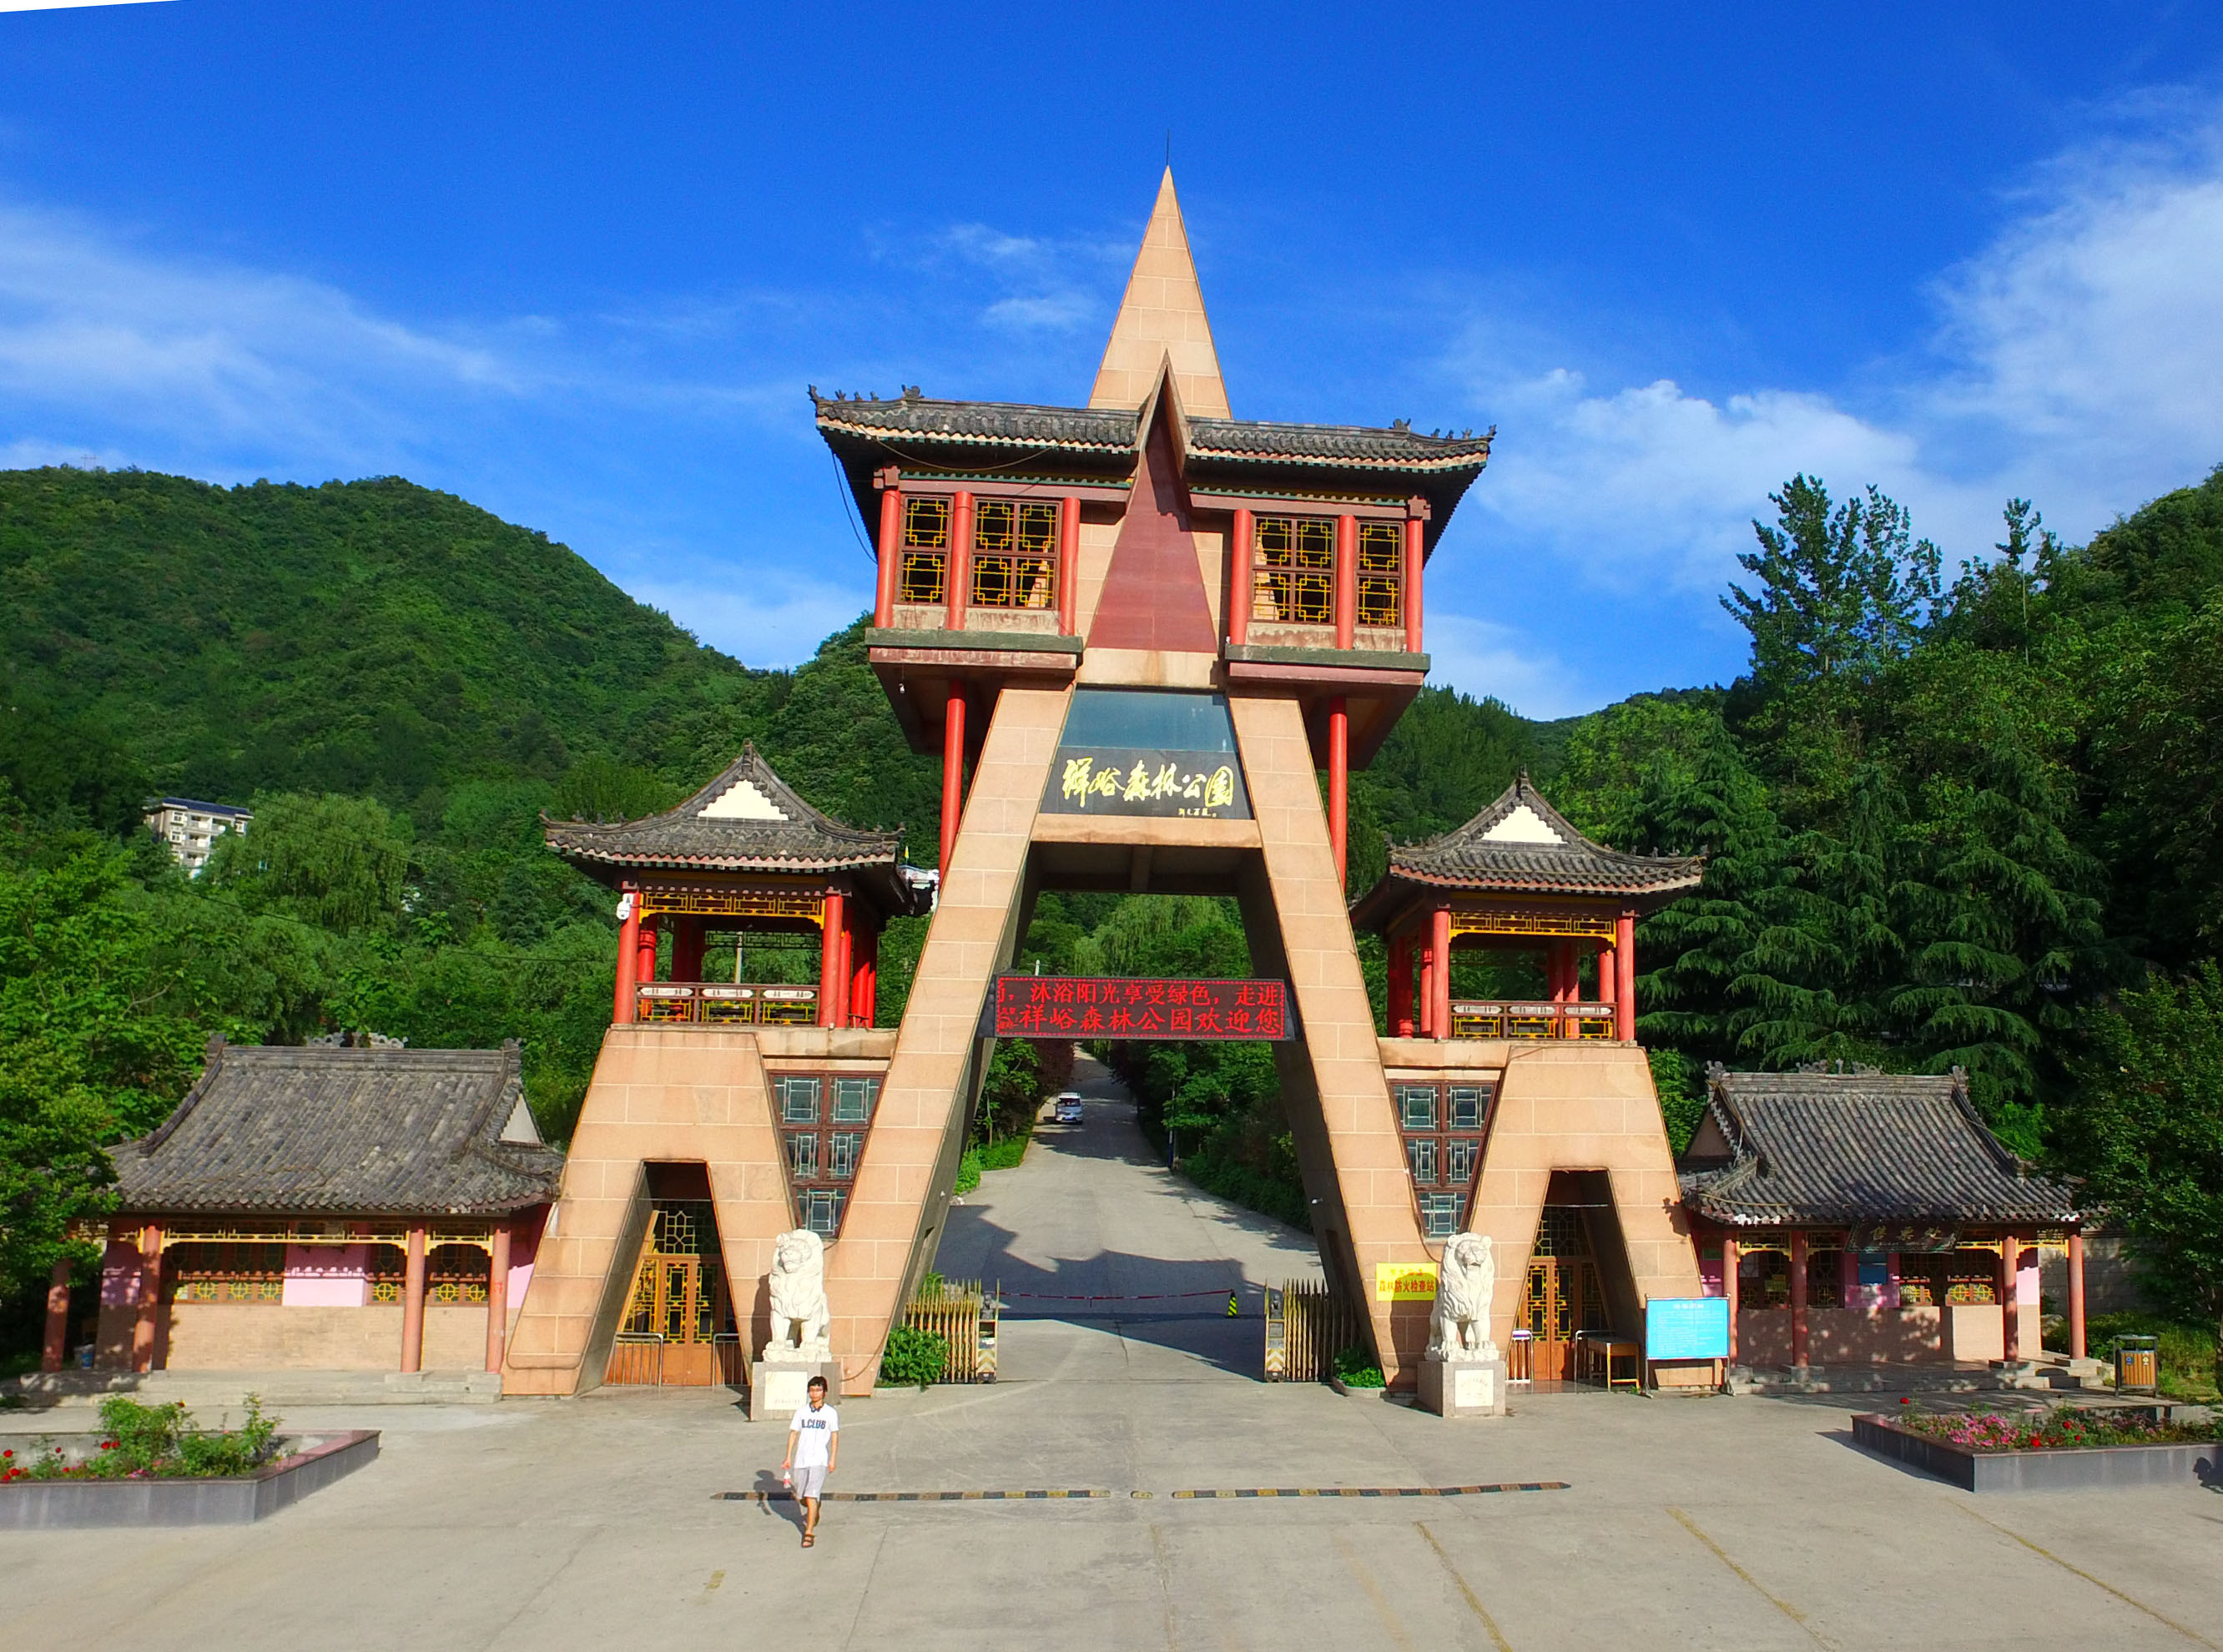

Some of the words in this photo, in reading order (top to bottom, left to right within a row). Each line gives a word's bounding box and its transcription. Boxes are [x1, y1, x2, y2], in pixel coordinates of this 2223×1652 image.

[1019, 1004, 1281, 1035] 祥峪森林公园欢迎您
